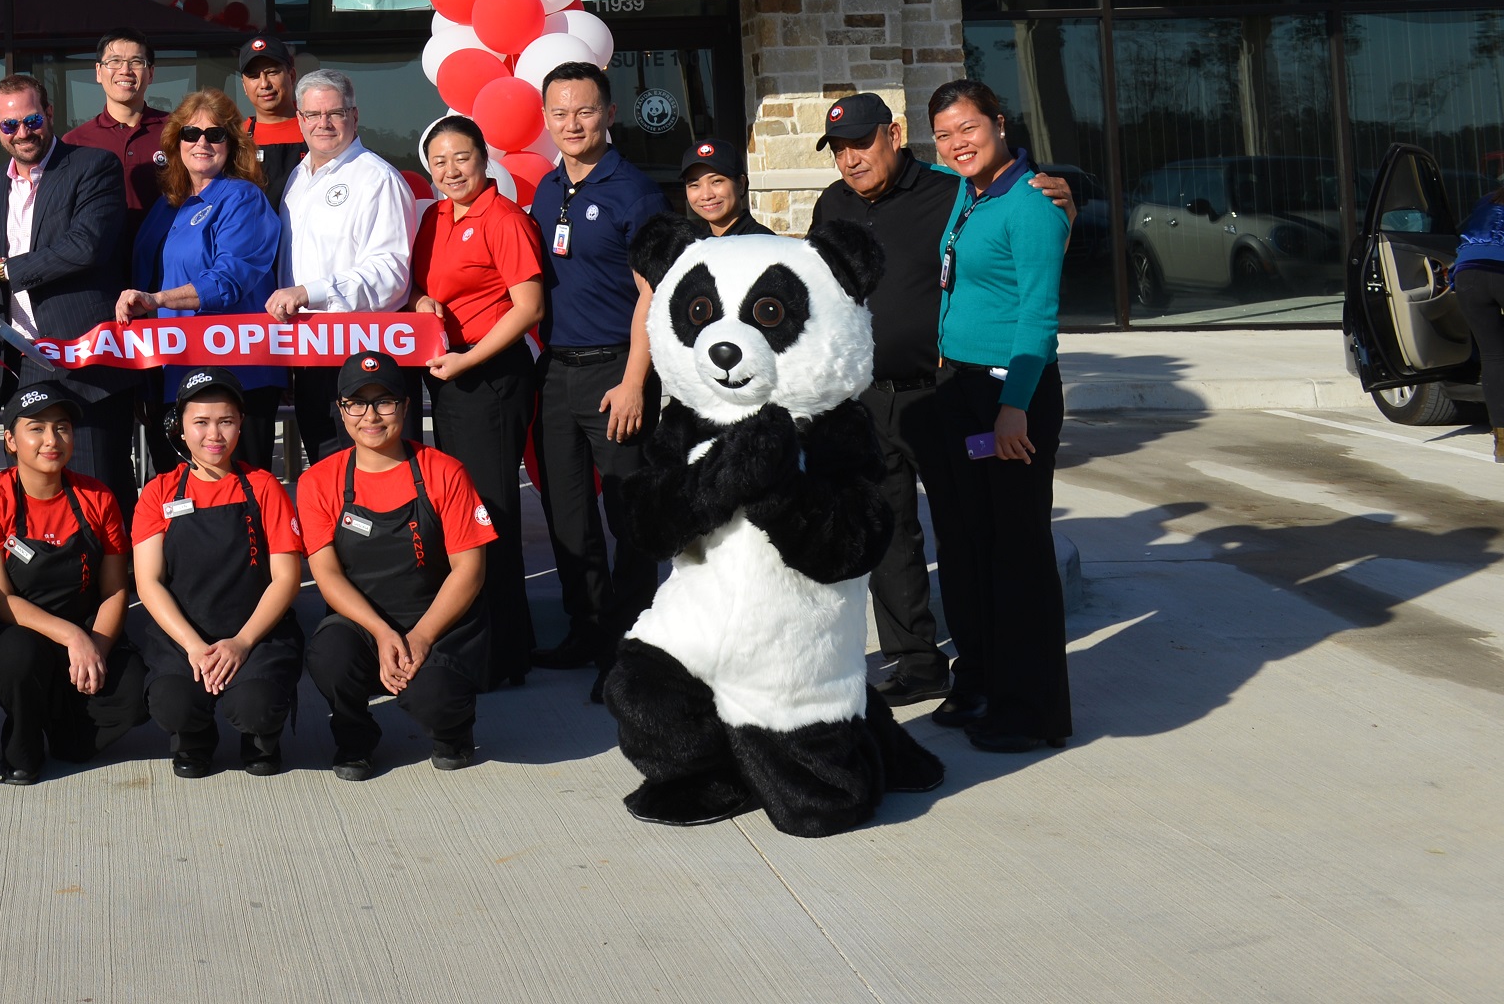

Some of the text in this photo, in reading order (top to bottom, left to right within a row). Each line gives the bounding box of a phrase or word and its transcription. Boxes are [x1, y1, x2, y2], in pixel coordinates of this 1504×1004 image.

[593, 0, 645, 13] 11939
[637, 90, 676, 109] PANDA EXPRESS
[34, 323, 416, 364] GRAND OPENING
[186, 375, 213, 389] GOOD
[187, 372, 205, 382] TSO
[20, 390, 39, 402] TSO
[21, 393, 49, 408] GOOD
[245, 516, 258, 566] PANDA
[408, 521, 425, 568] PANDA
[81, 553, 91, 594] PANDA
